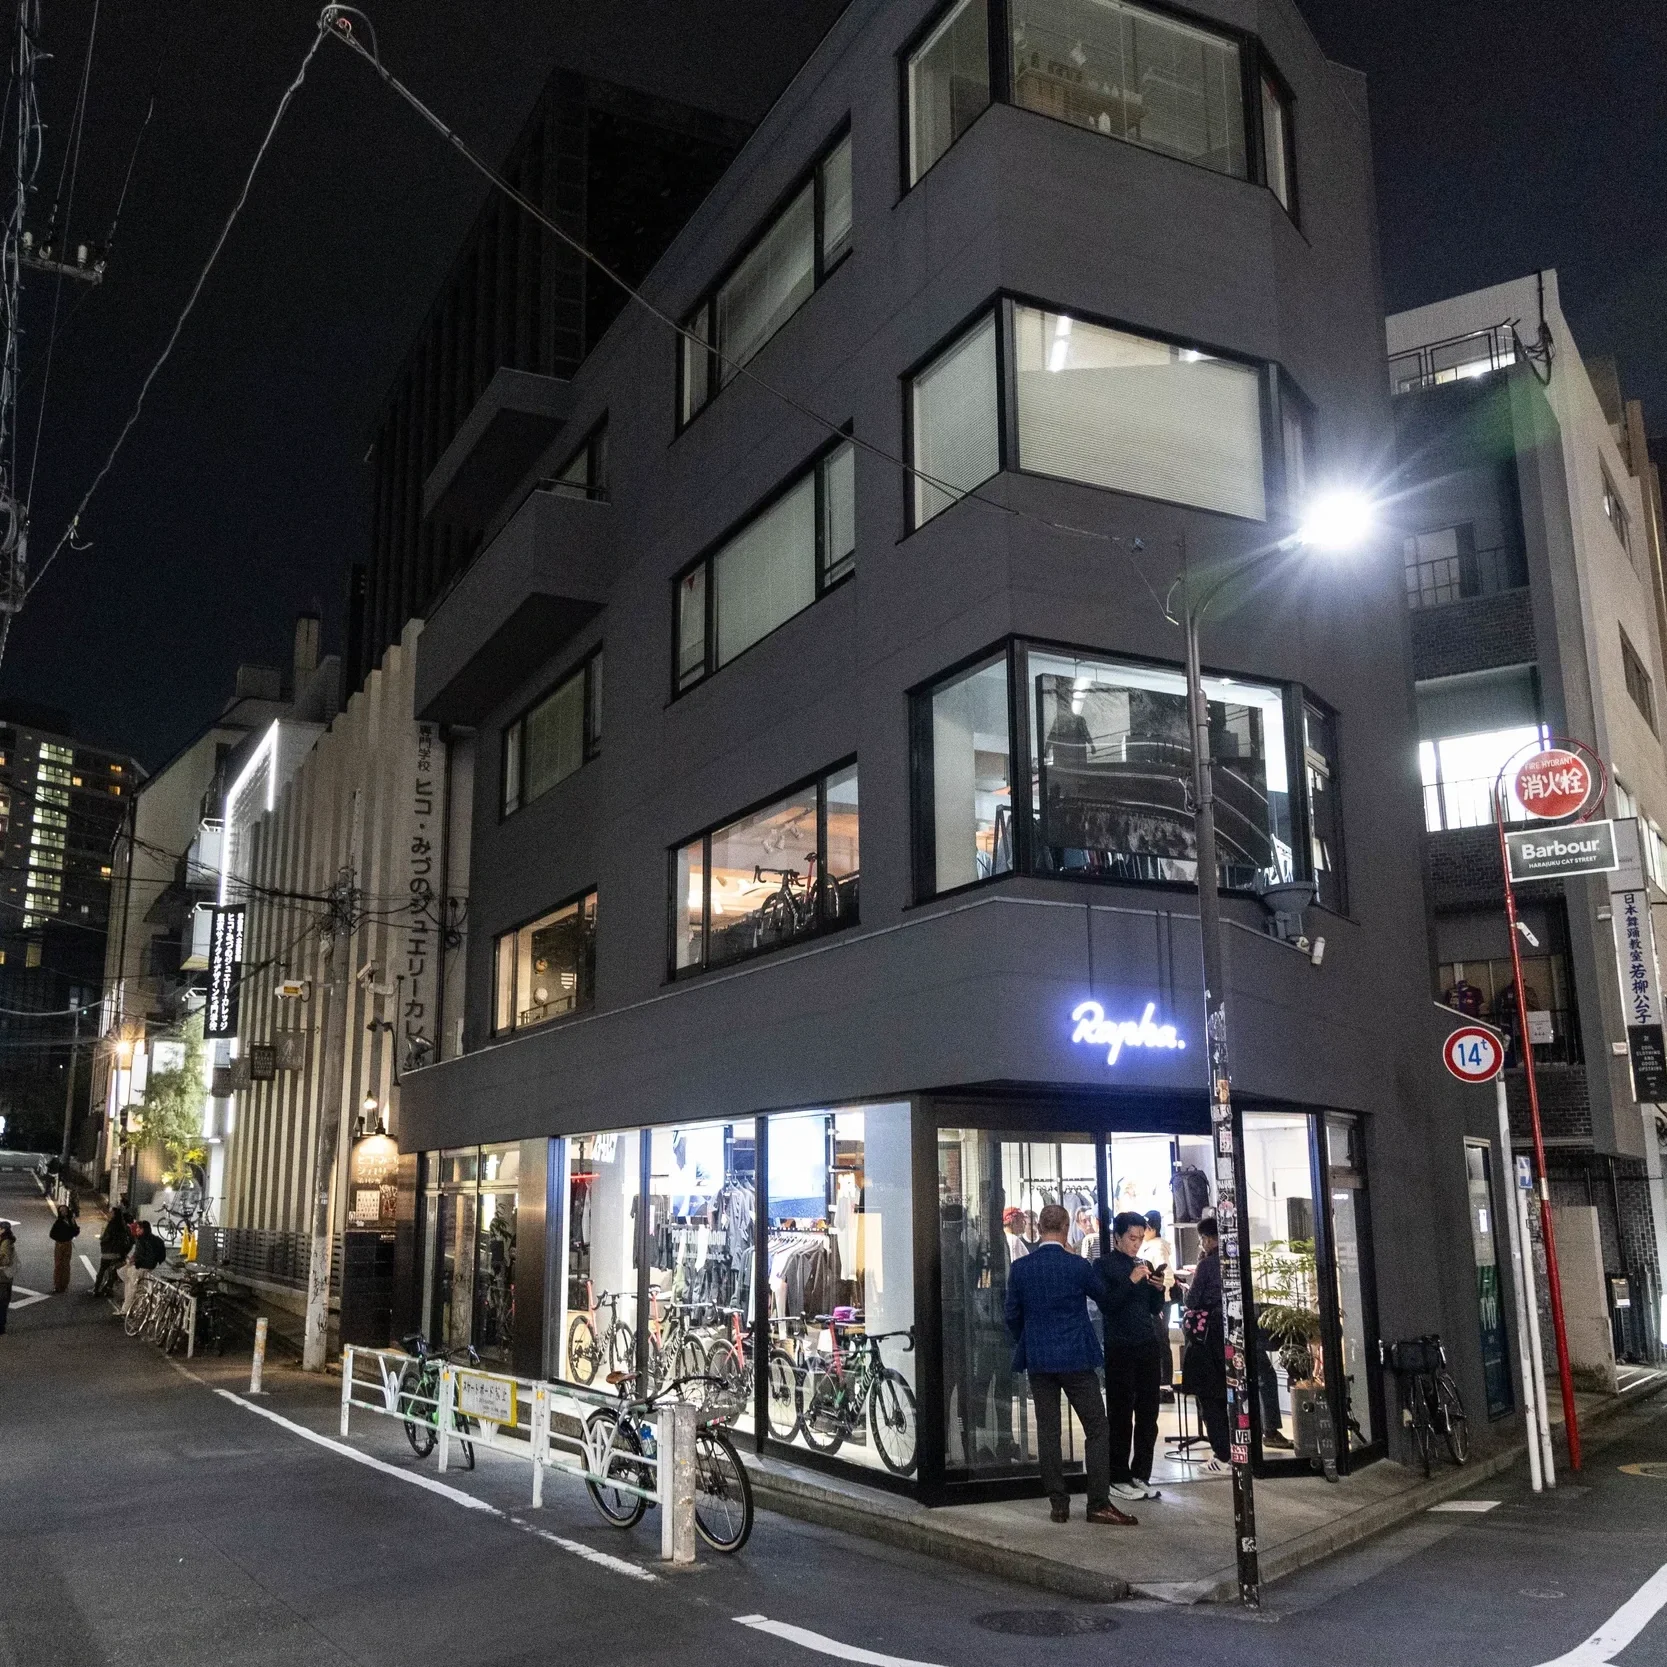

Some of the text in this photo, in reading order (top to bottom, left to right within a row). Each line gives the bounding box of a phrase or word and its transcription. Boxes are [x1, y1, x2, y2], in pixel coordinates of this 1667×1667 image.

[1525, 757, 1574, 771] FIRE HYDRANT
[1521, 767, 1584, 801] 消火栓
[1528, 860, 1561, 869] HARAJUKU
[1574, 855, 1597, 864] STREET
